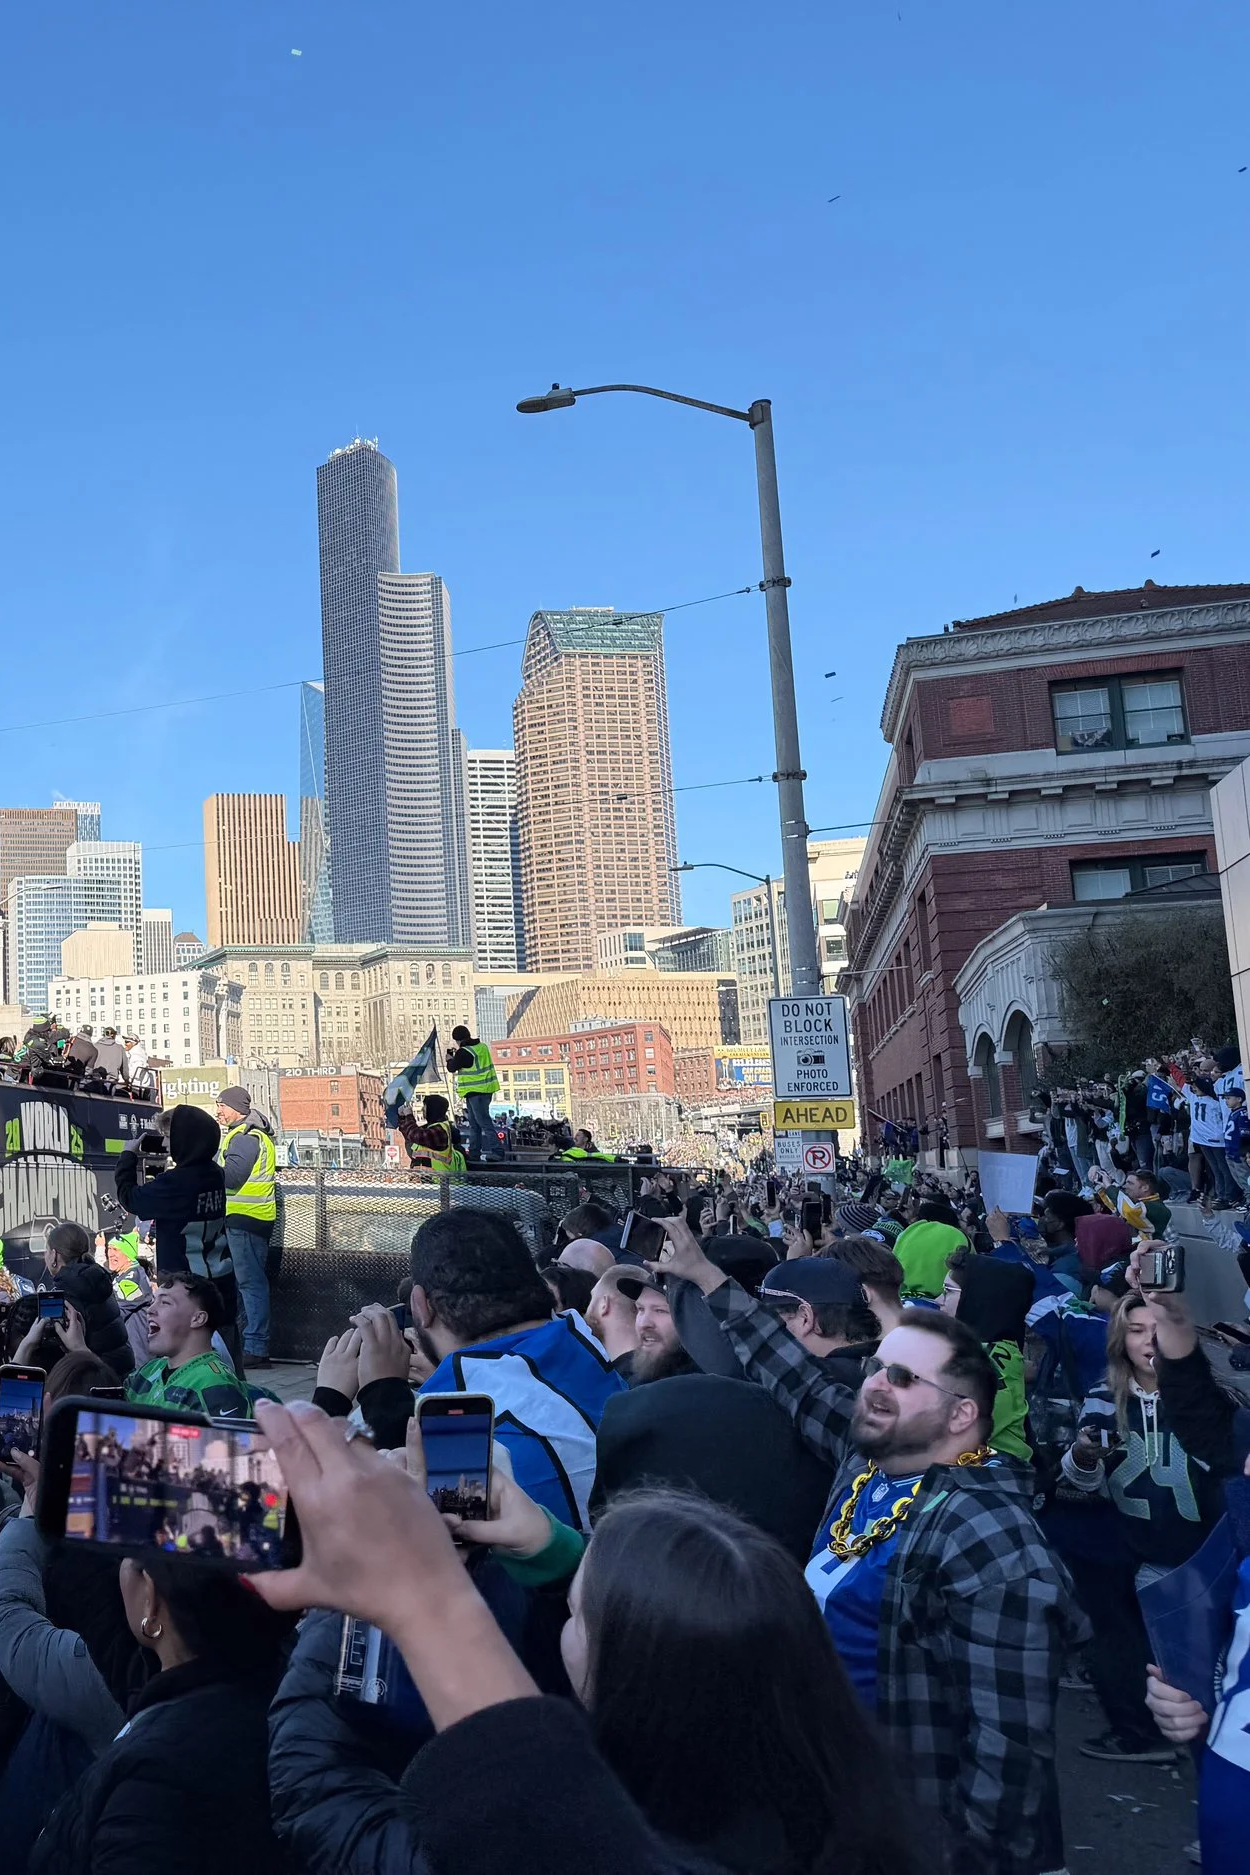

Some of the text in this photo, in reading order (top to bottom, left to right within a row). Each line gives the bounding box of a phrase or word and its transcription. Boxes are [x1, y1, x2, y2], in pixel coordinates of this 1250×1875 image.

[781, 1002, 832, 1017] DO NOT
[784, 1019, 833, 1033] BLOCK
[780, 1034, 839, 1046] INTERSECTION
[285, 1066, 336, 1077] 210 THIRD
[796, 1069, 828, 1079] PHOTO
[161, 1077, 220, 1099] ighting
[787, 1082, 839, 1092] ENFORCED
[782, 1107, 848, 1123] AHEAD
[1194, 1101, 1207, 1122] 11
[20, 1101, 70, 1153] WORLD
[196, 1190, 223, 1214] FAN
[1109, 1431, 1201, 1522] 24
